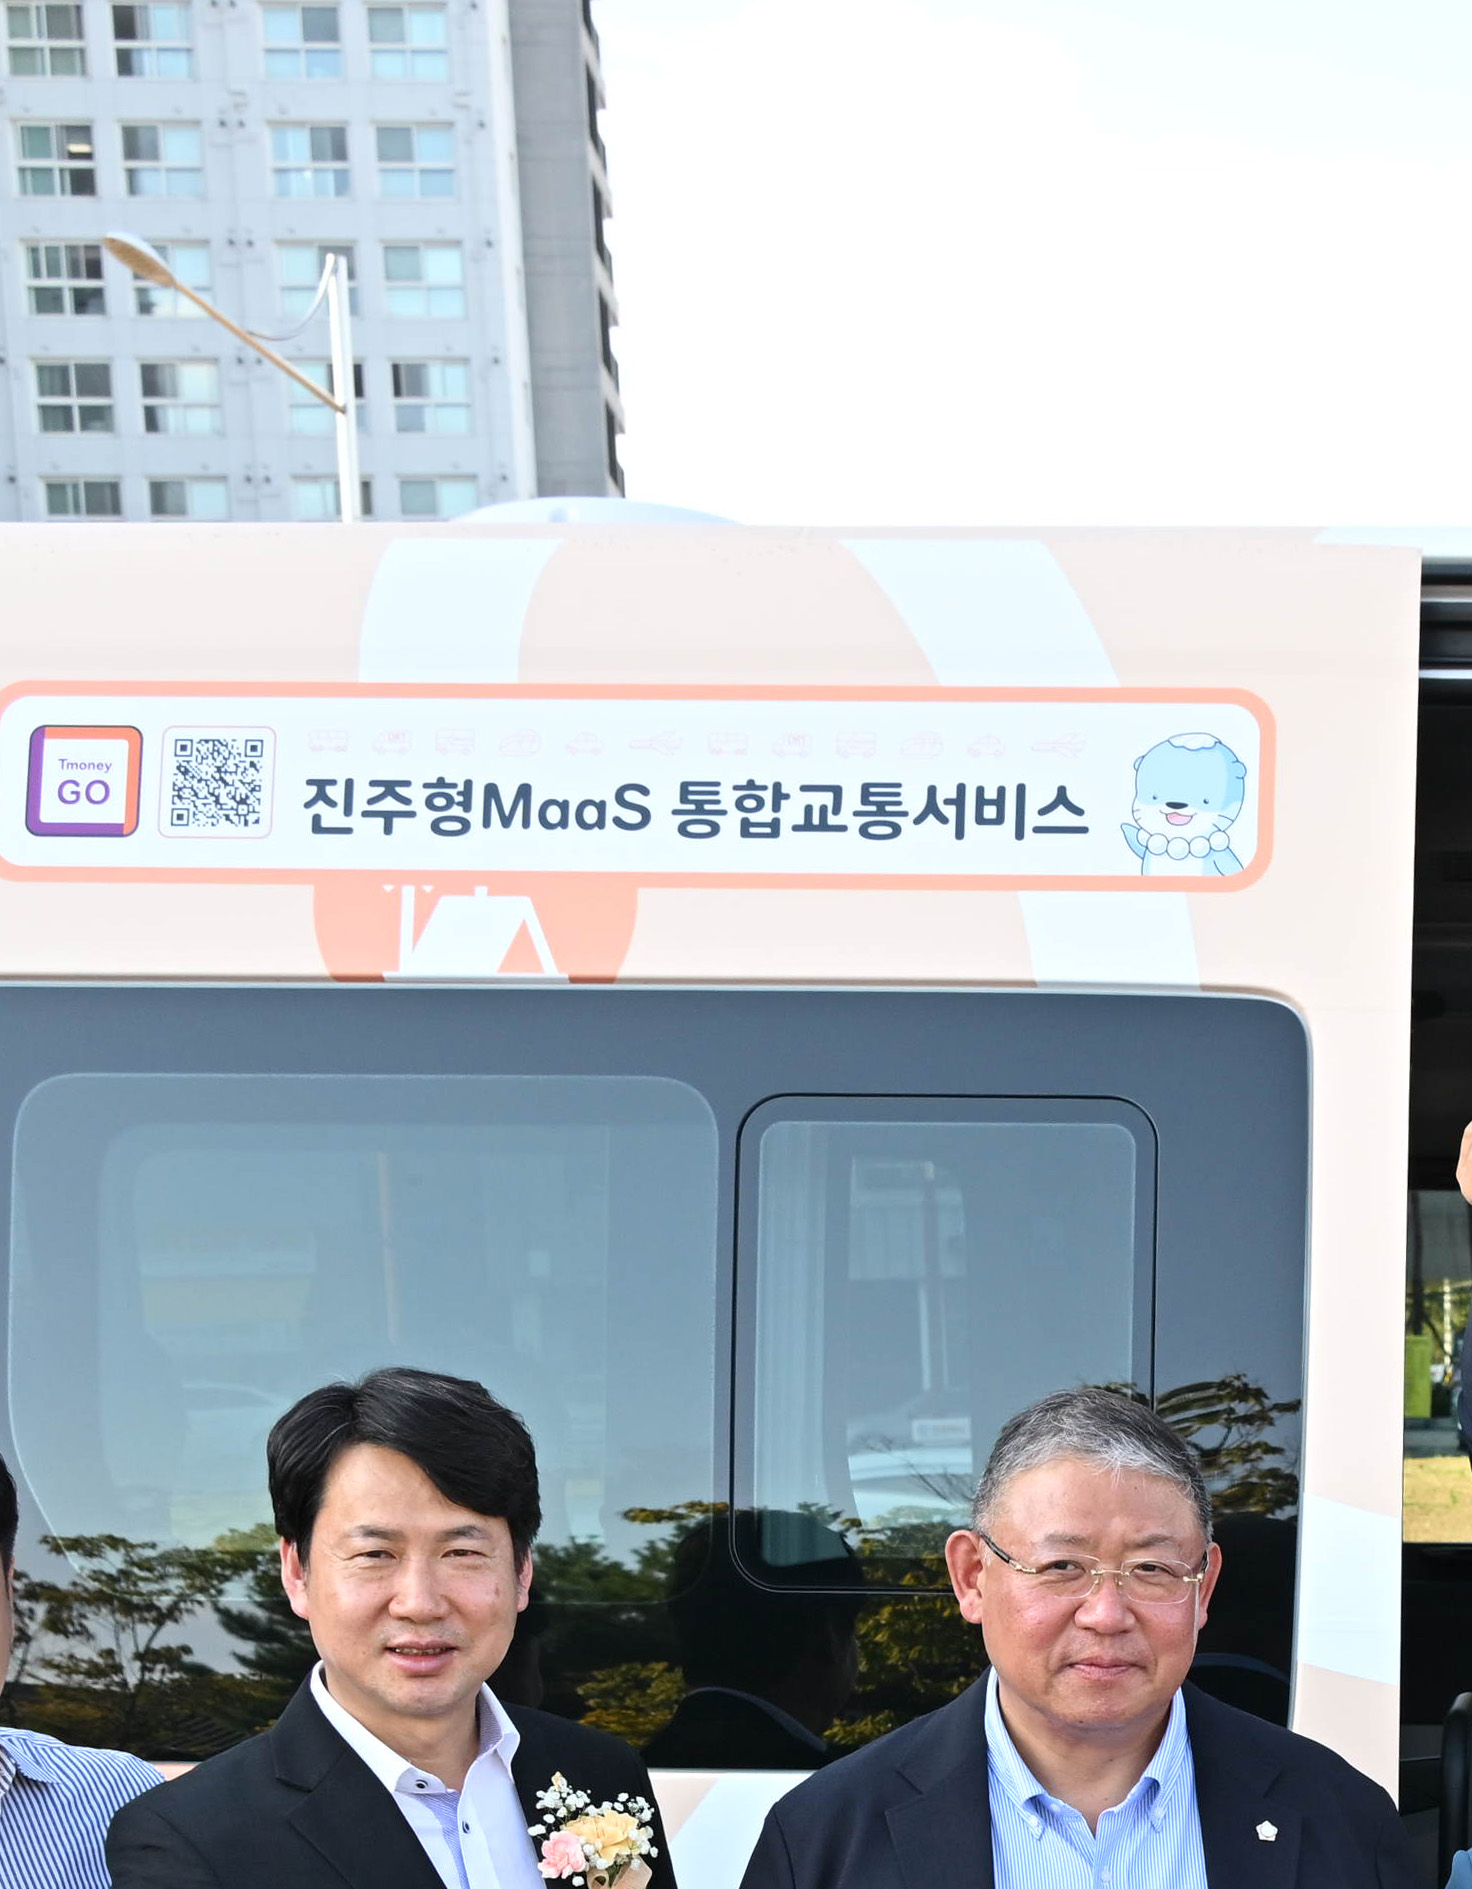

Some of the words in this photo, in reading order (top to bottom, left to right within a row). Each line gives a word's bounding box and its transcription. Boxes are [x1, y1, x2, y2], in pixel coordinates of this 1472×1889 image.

[58, 758, 113, 773] Tmoney
[57, 779, 111, 805] GO
[303, 776, 652, 838] 진주형MaaS
[671, 778, 1090, 842] 통합교통서비스
